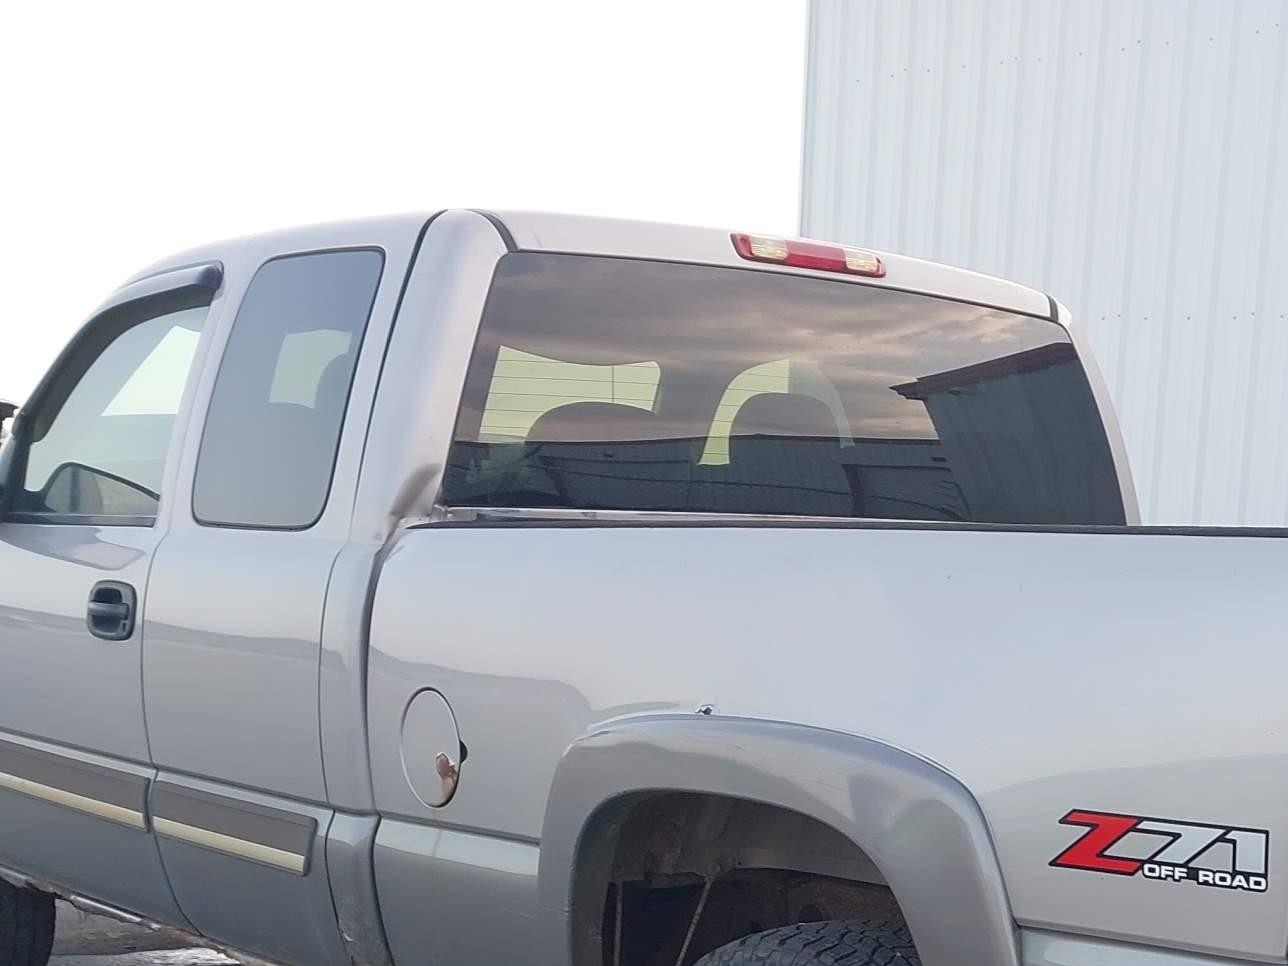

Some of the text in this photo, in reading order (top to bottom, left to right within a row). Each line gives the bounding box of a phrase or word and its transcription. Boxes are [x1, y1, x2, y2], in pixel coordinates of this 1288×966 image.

[1049, 809, 1269, 876] Z71
[1142, 863, 1268, 891] OFF ROAD
